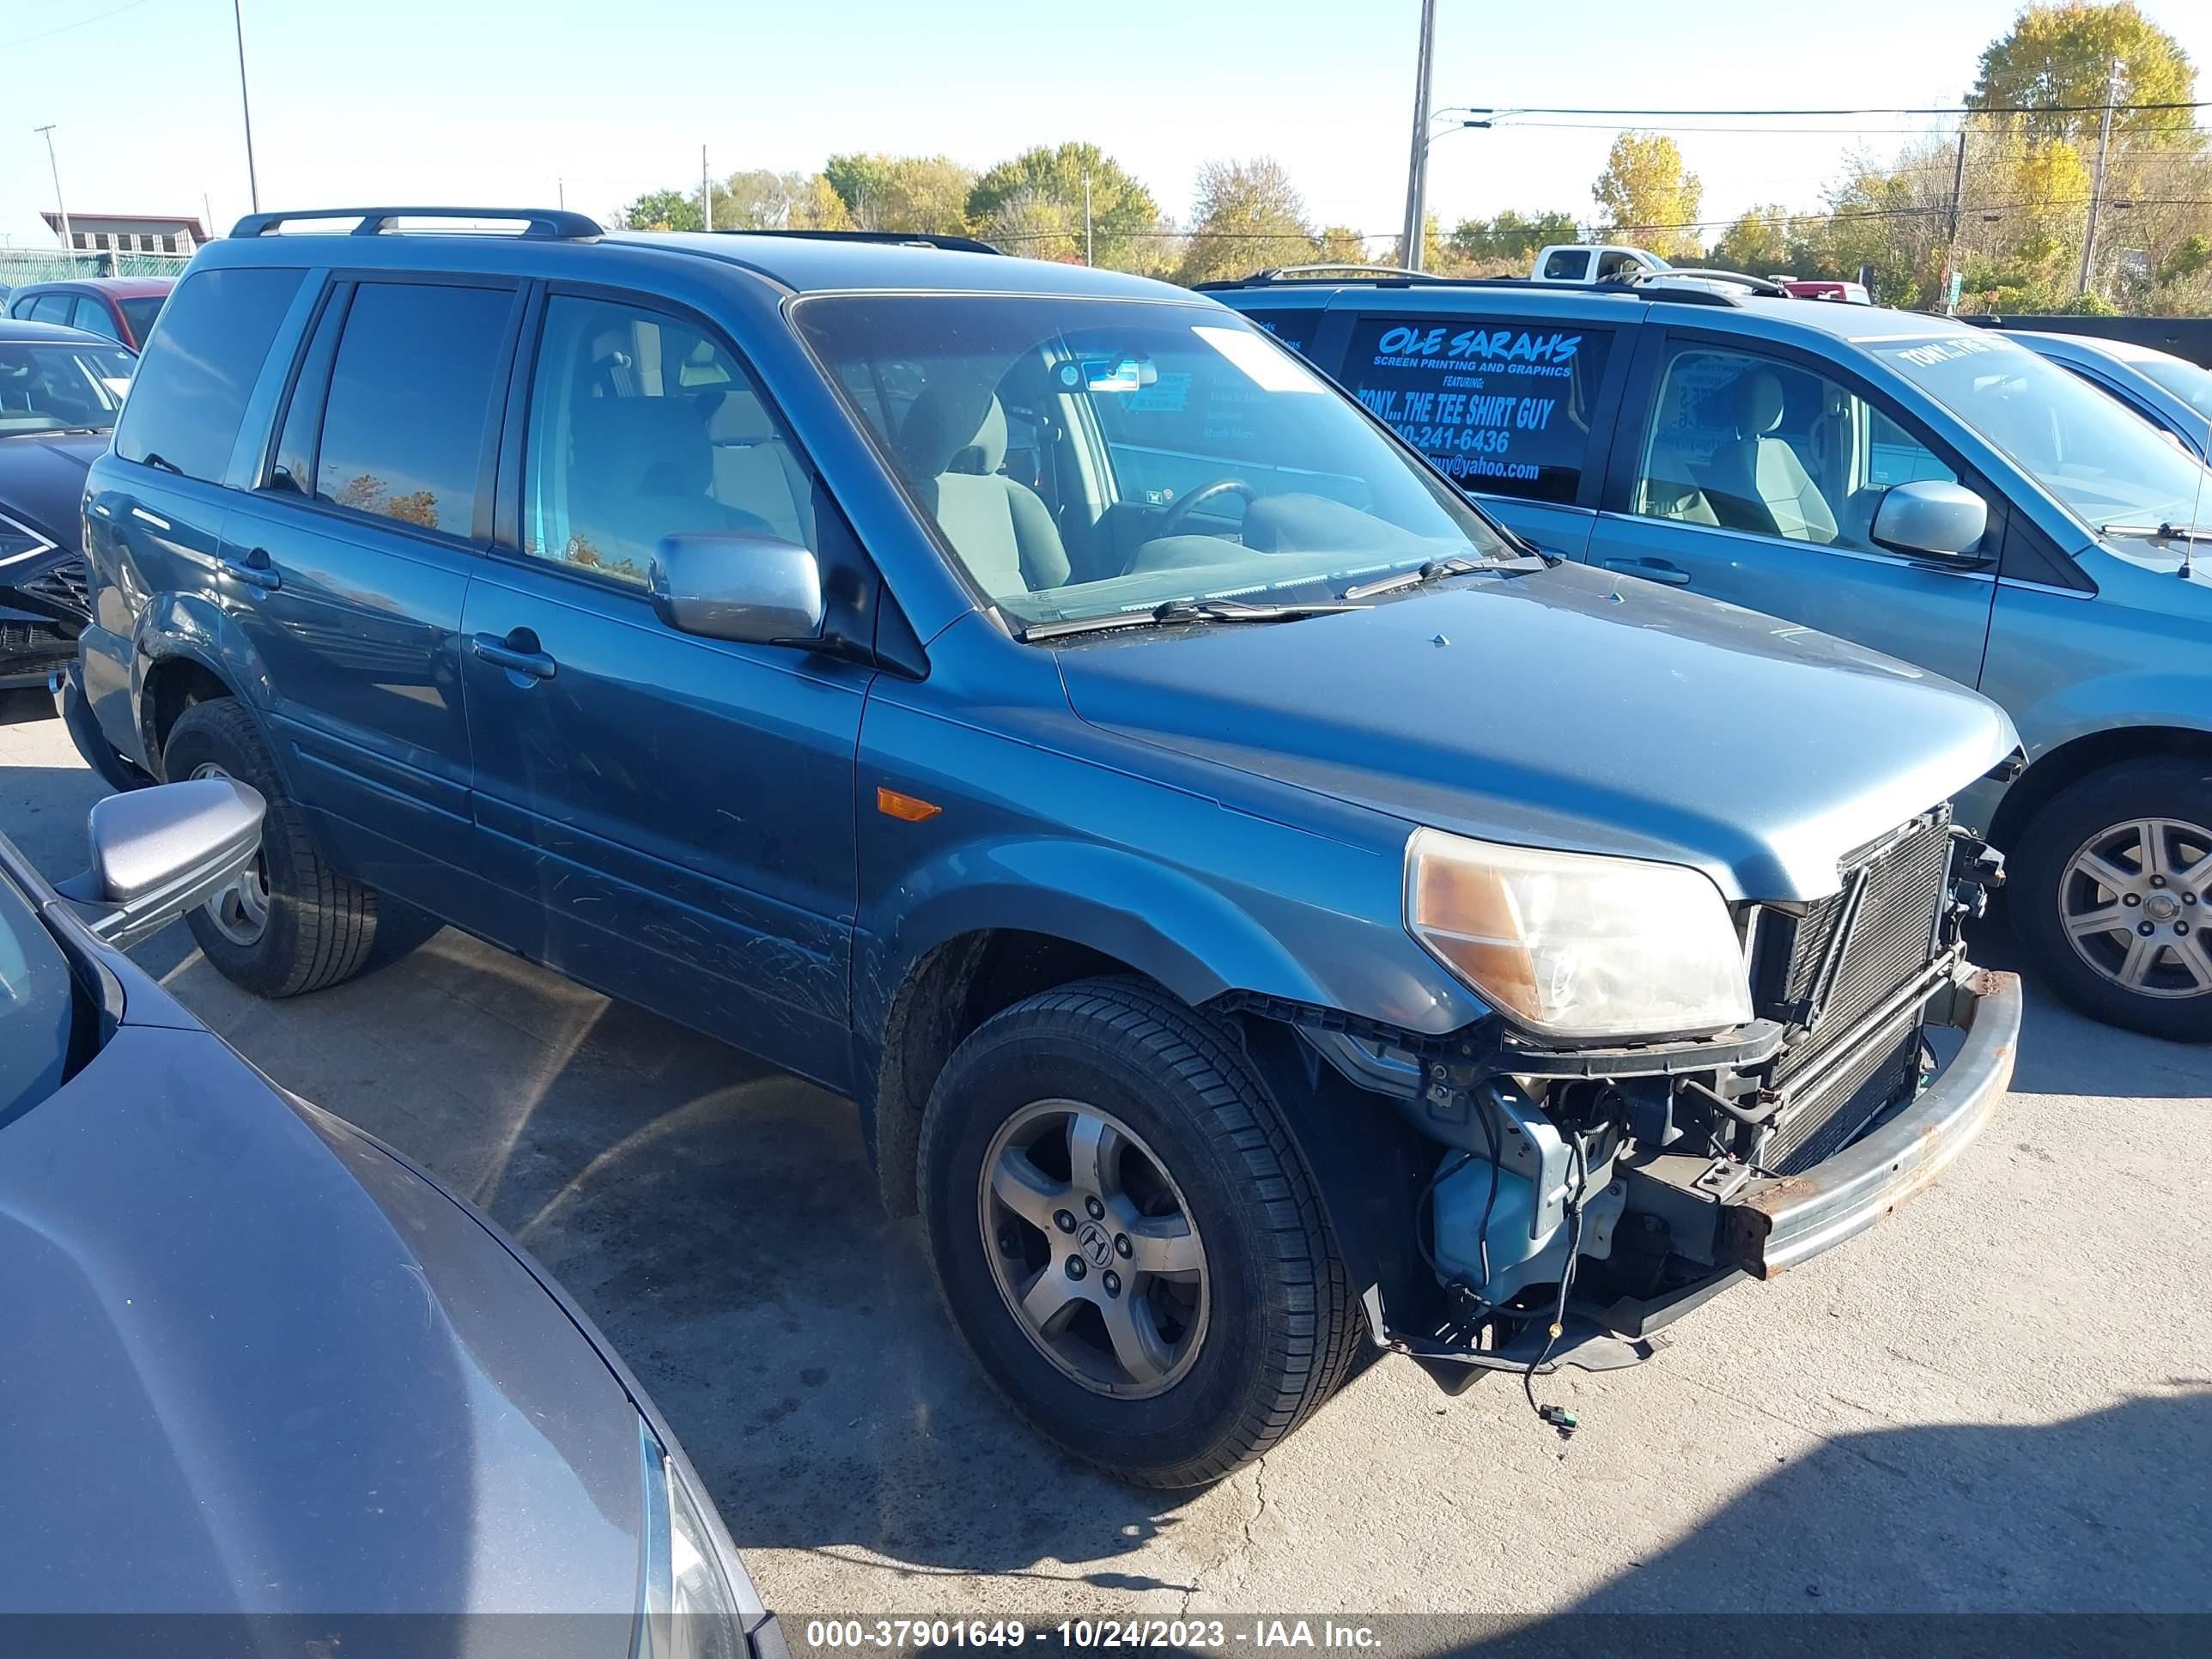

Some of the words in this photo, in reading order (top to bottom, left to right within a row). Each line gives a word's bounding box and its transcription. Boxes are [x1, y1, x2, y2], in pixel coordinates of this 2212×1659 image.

[1379, 327, 1446, 356] OLE
[1448, 330, 1582, 363] SARAH'S
[1373, 356, 1418, 368] SCREEN
[1419, 359, 1476, 371] PRINTING
[1478, 362, 1504, 373] AND
[1507, 364, 1571, 377] GRAPHICS
[1436, 394, 1466, 424] TEE
[1466, 394, 1516, 428] SHIRT
[1516, 398, 1555, 429] GUY
